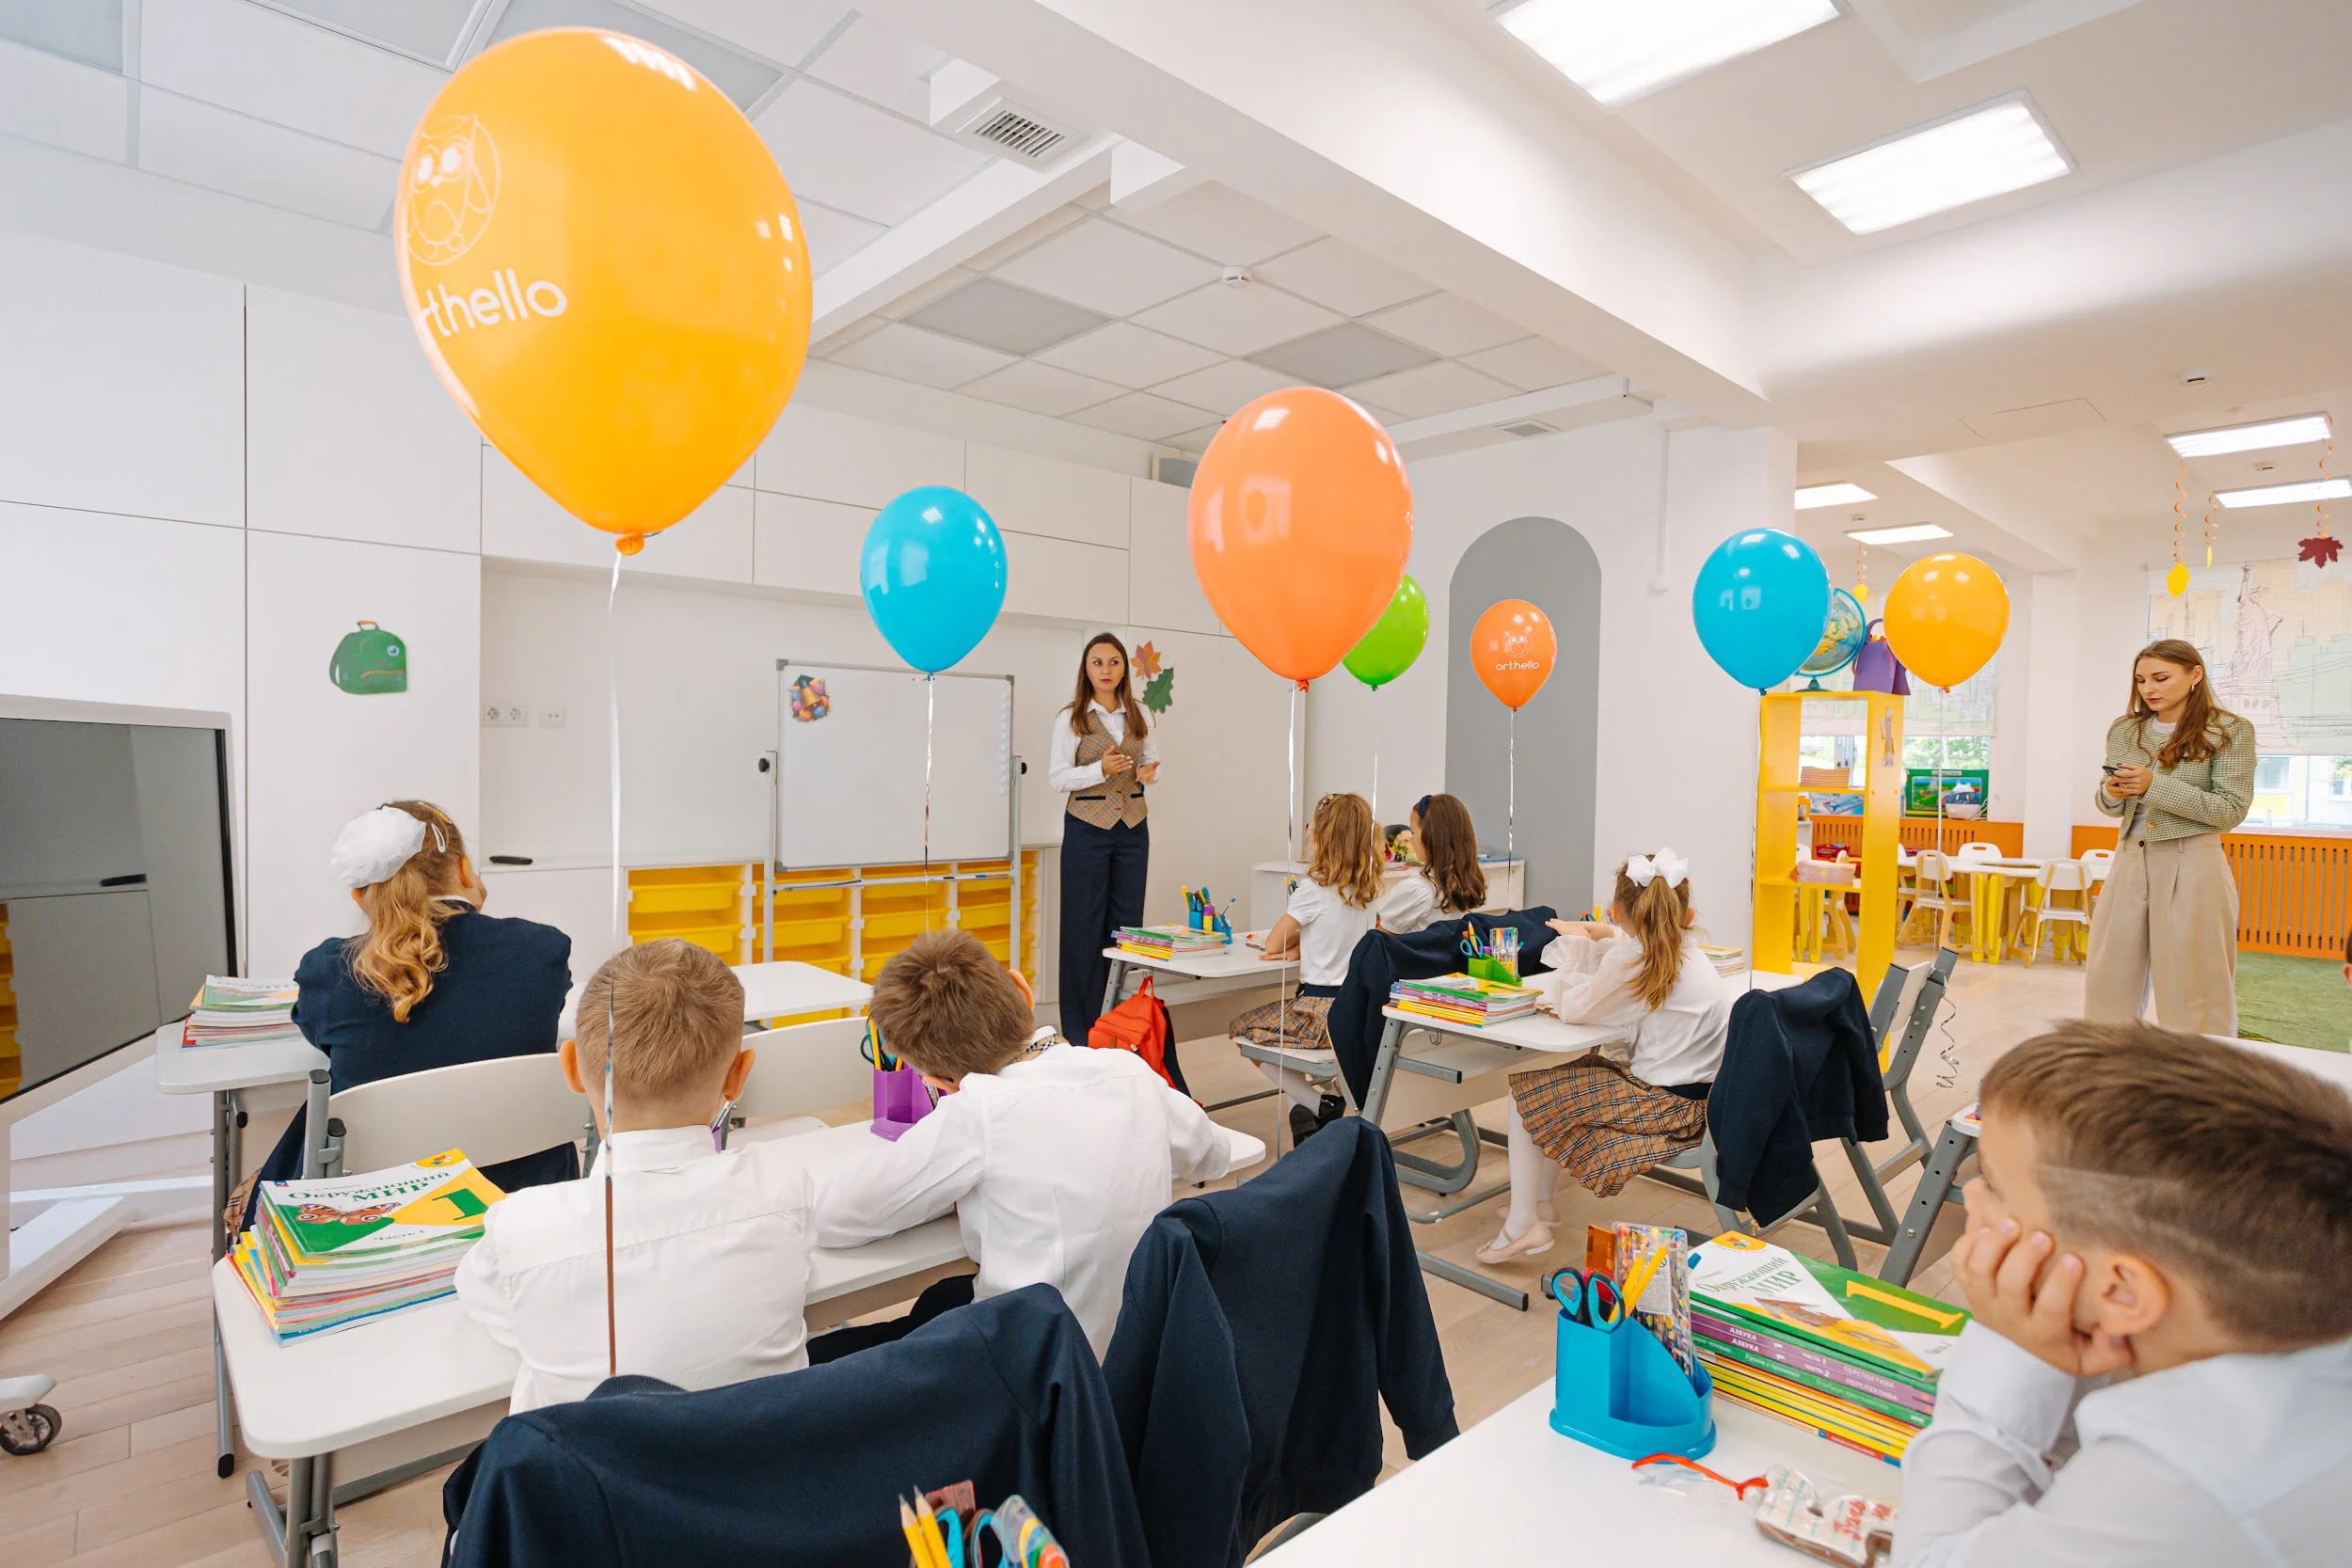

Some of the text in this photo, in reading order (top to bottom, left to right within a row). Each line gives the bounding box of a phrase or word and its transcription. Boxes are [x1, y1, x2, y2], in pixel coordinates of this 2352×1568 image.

[416, 267, 567, 339] rthello
[1495, 659, 1540, 671] arthello
[288, 1171, 451, 1199] Окружающий
[430, 1187, 488, 1222] 1
[1695, 1256, 1790, 1292] Окружающий
[1846, 1279, 1964, 1330] 1
[1729, 1326, 1757, 1341] АЗБУКА
[1843, 1366, 1895, 1389] ПЕРСПЕКТИВА
[1731, 1338, 1759, 1353] АЗБУКА
[1846, 1377, 1899, 1402] ПЕРСПЕКТИВА
